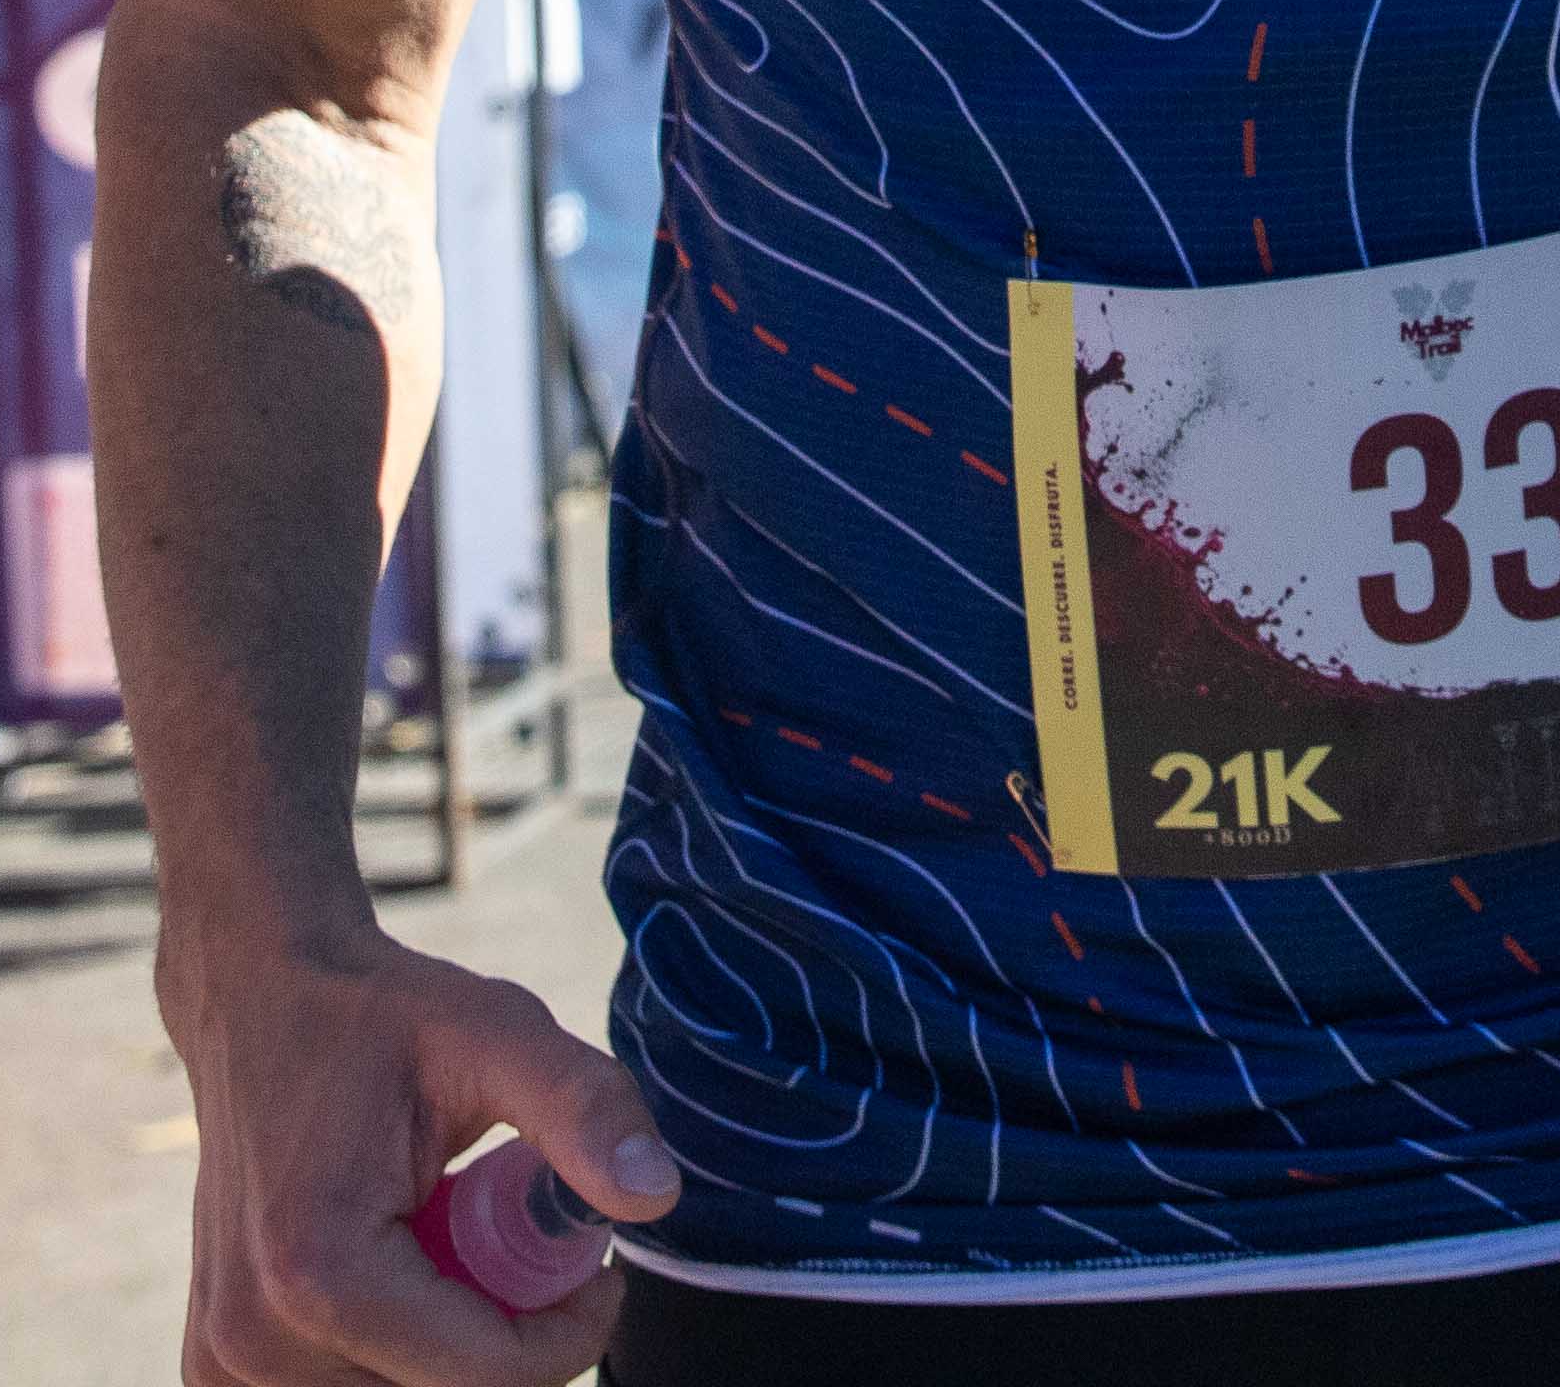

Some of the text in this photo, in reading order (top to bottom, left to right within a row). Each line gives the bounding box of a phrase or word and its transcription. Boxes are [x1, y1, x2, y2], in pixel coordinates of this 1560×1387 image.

[1400, 315, 1475, 343] Malbec
[1415, 335, 1462, 360] Trail
[1151, 745, 1343, 829] 21K
